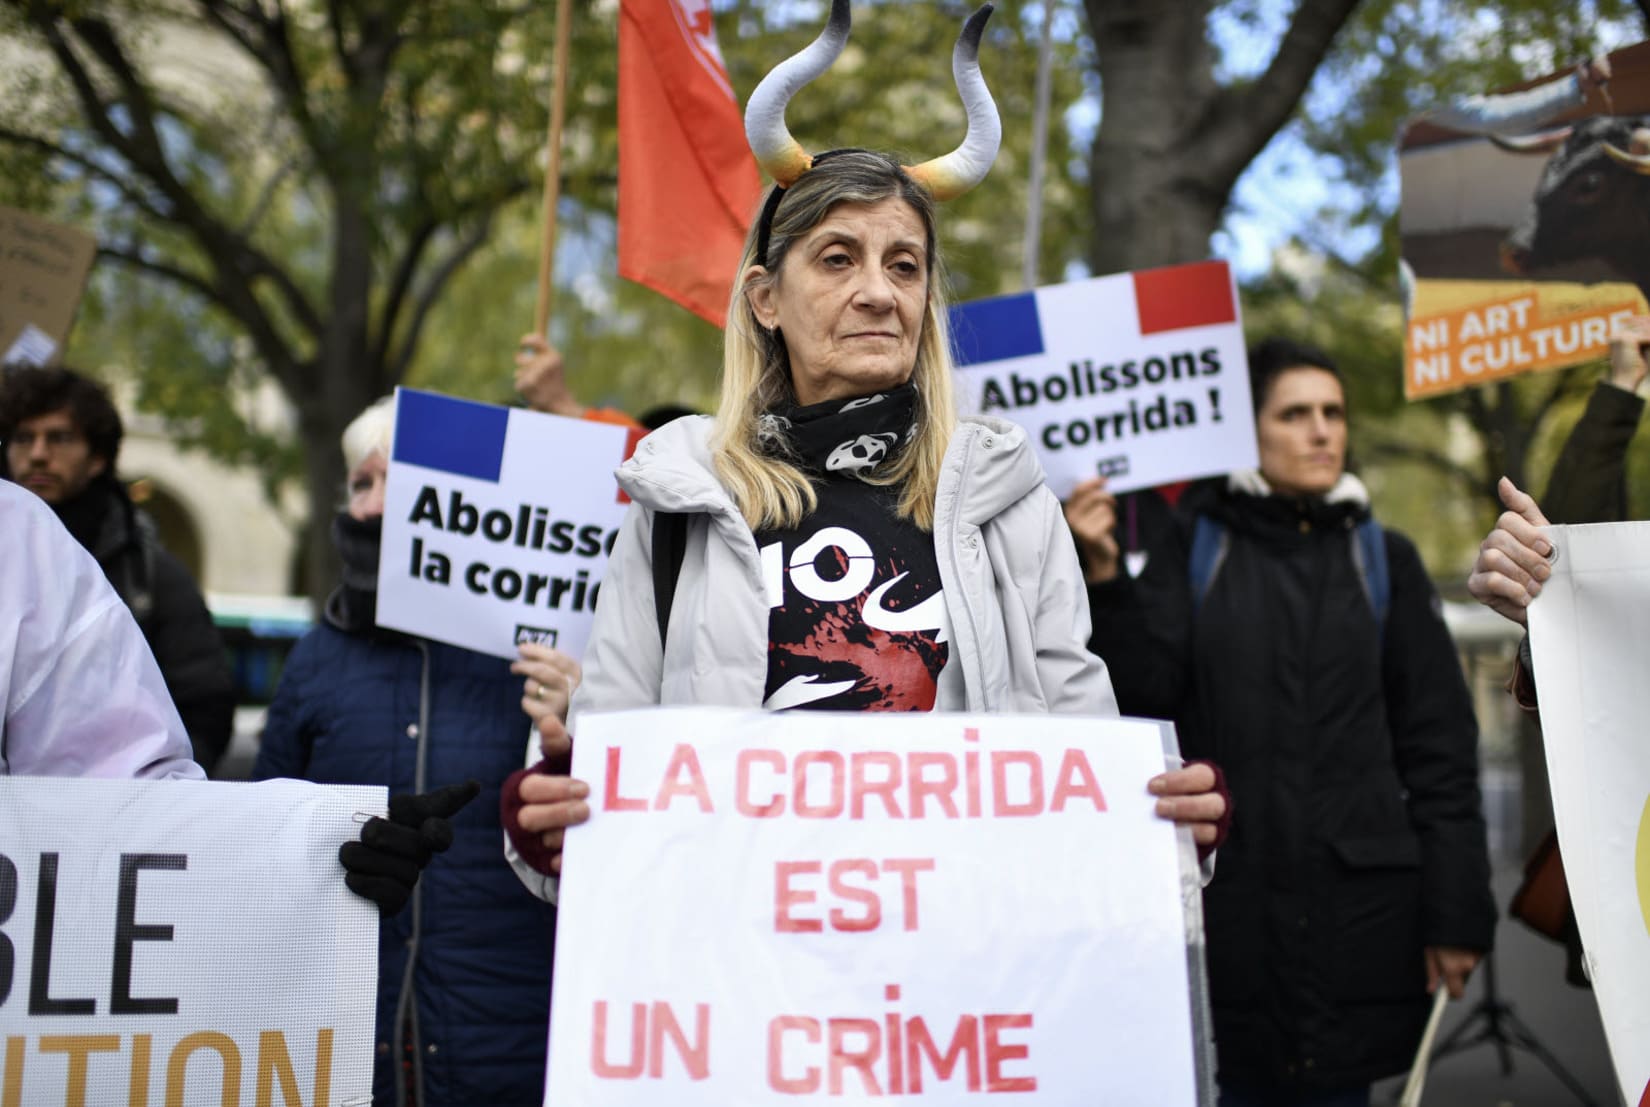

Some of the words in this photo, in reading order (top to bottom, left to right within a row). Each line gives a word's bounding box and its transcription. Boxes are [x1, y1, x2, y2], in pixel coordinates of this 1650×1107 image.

[1412, 319, 1448, 352] NI
[1459, 298, 1533, 342] ART
[980, 347, 1222, 412] Abolissons
[1413, 355, 1450, 386] NI
[1041, 394, 1196, 451] corrida
[409, 538, 451, 586] la
[464, 561, 601, 614] corri
[602, 743, 714, 813] LA
[774, 858, 934, 933] EST
[0, 851, 188, 1016] LE
[590, 1000, 711, 1080] UN
